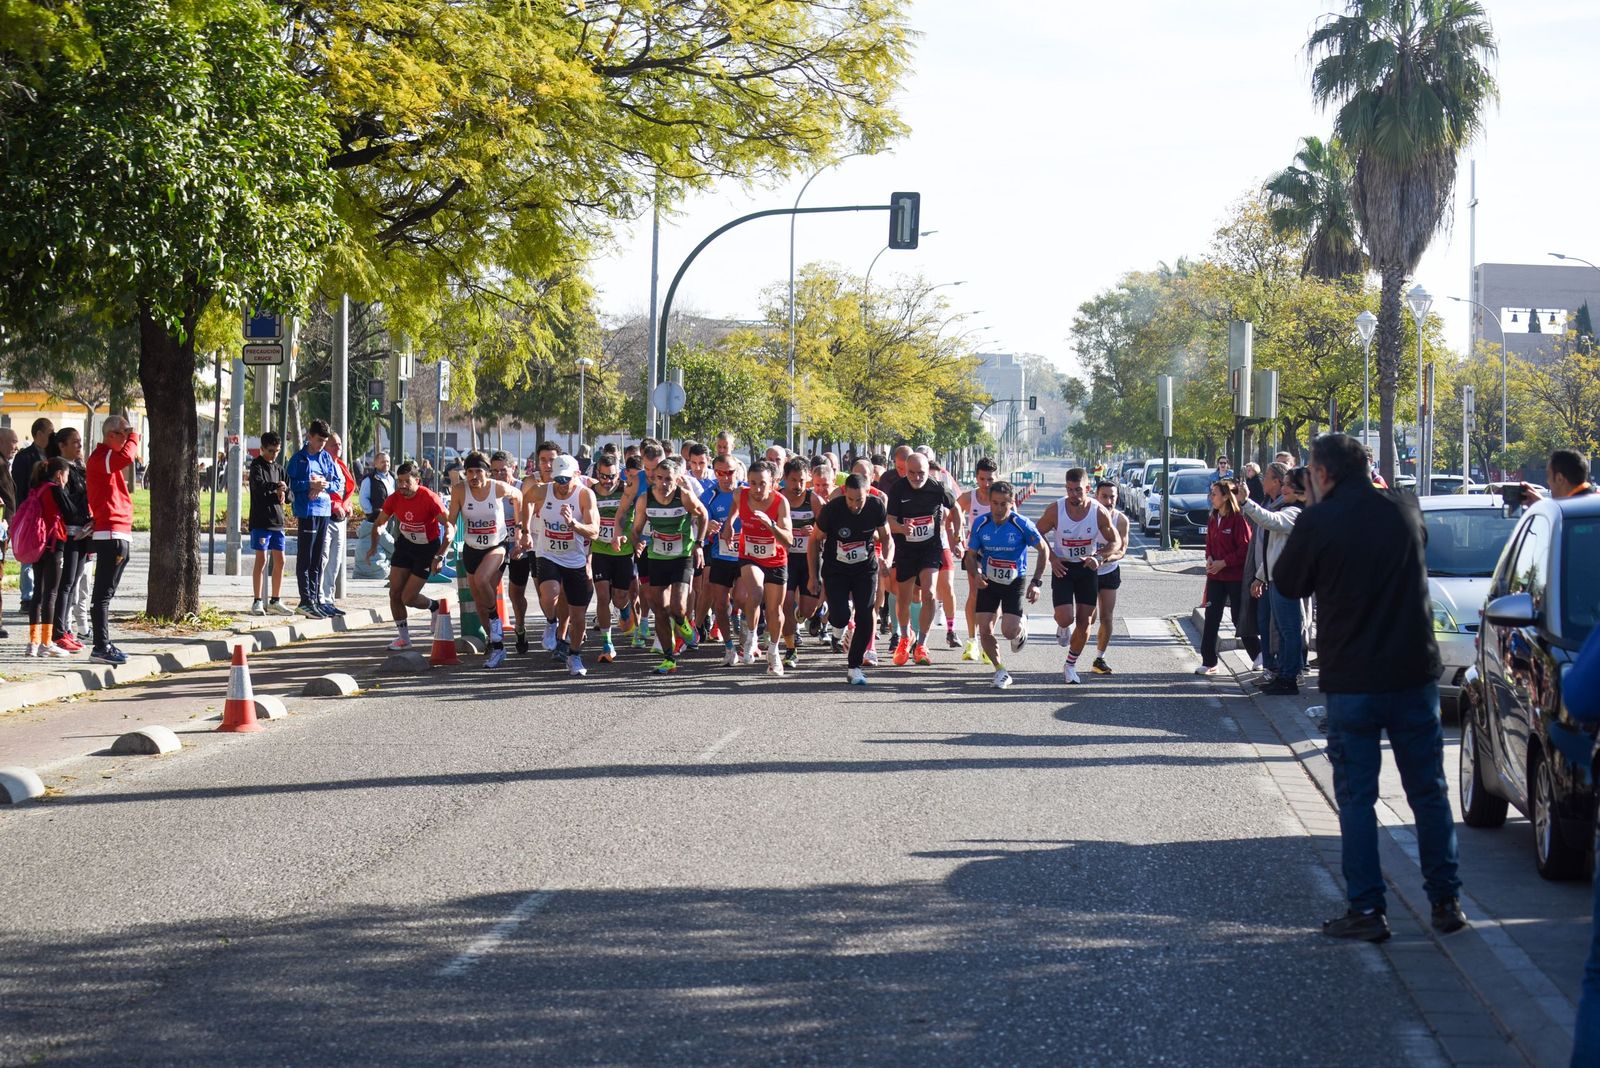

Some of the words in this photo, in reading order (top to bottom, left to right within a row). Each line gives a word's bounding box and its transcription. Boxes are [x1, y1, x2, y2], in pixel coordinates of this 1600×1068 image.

[410, 532, 416, 540] 6
[913, 526, 928, 536] 102
[476, 535, 488, 544] 48
[550, 540, 568, 550] 216
[662, 542, 672, 551] 18
[754, 544, 766, 554] 88
[846, 550, 857, 560] 46
[1068, 547, 1086, 556] 138
[993, 568, 1010, 580] 134
